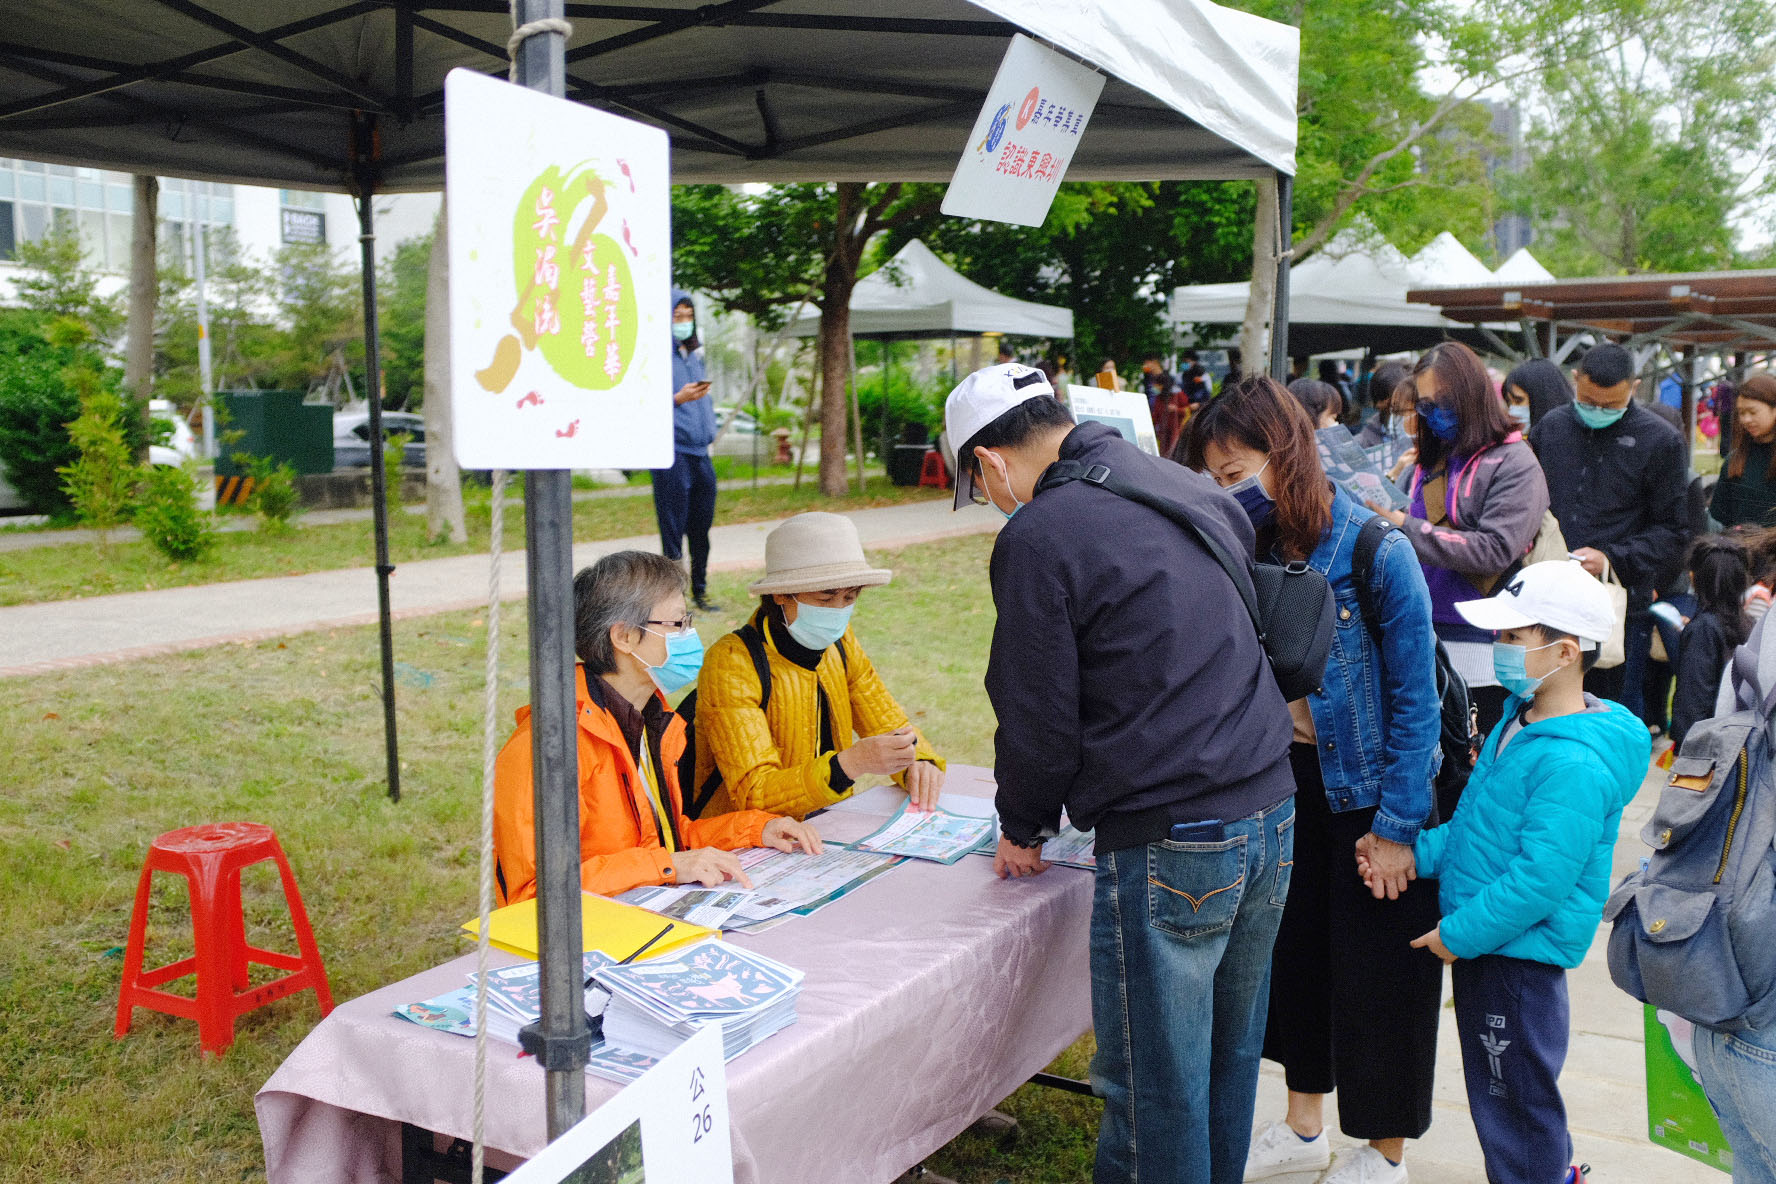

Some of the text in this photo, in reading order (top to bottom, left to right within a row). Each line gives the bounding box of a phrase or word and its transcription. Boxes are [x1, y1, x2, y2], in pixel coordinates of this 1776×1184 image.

[603, 262, 622, 382] 嘉年華
[689, 1066, 705, 1102] 公
[693, 1103, 712, 1144] 26
